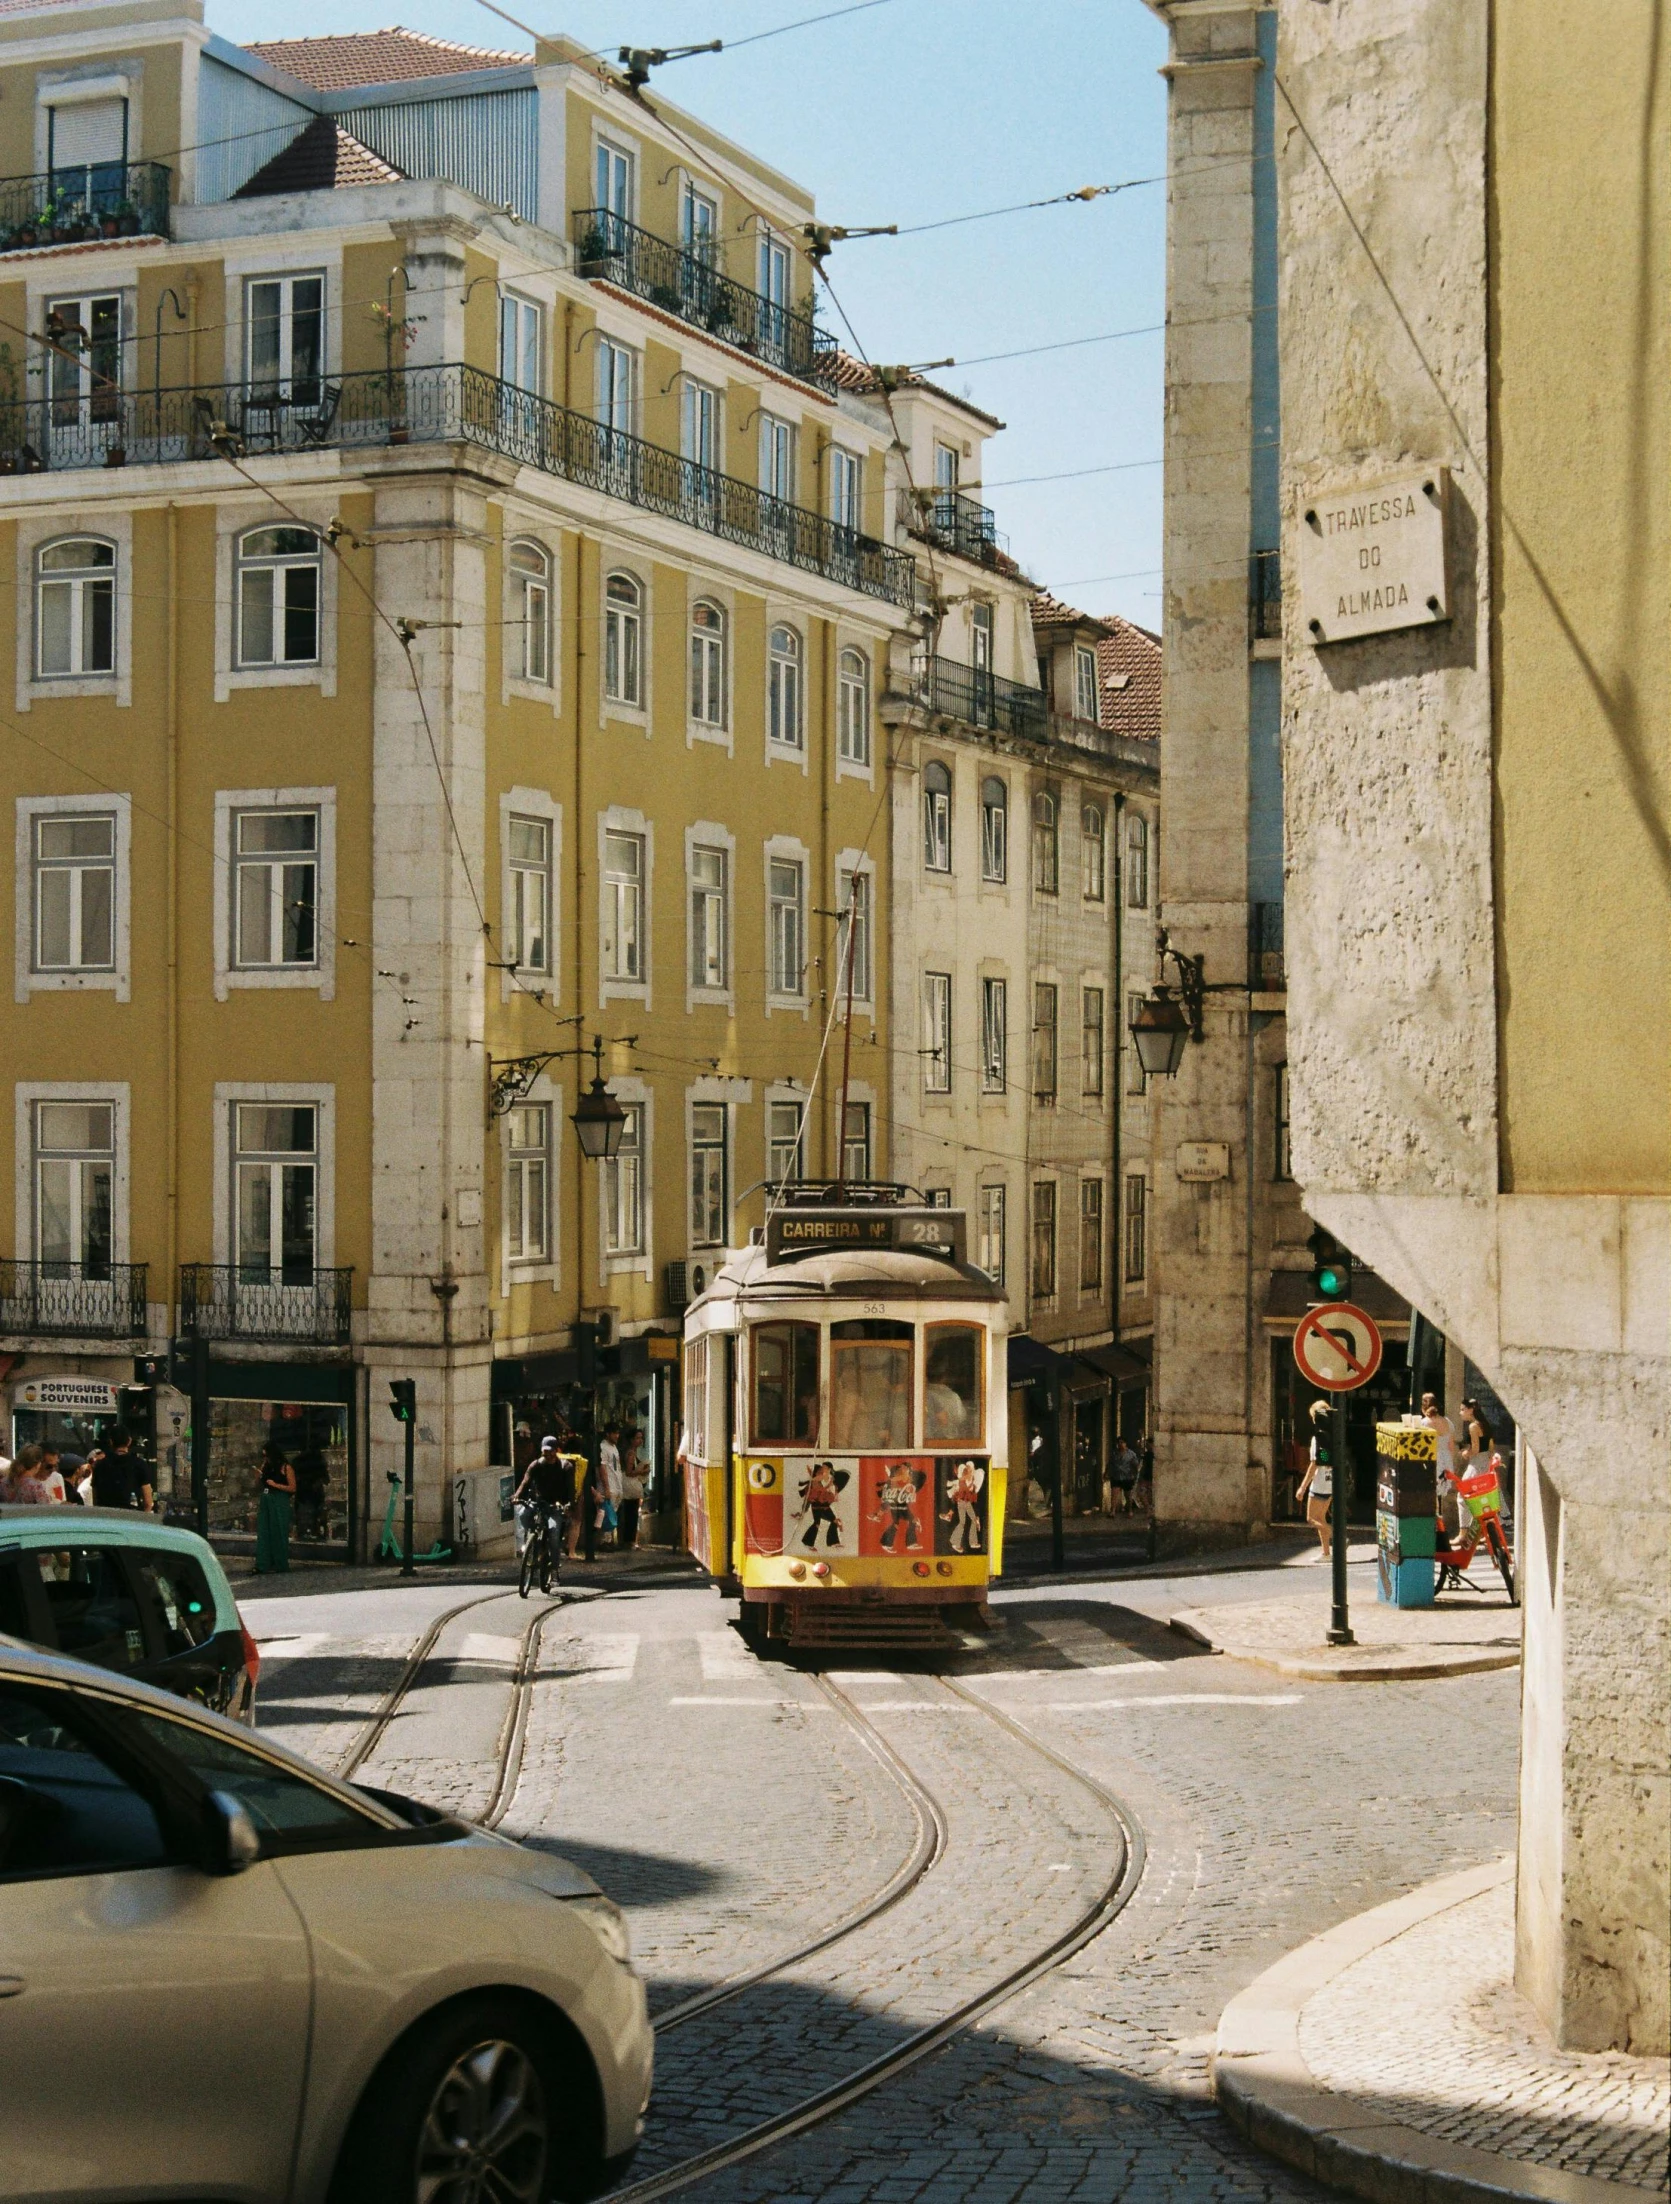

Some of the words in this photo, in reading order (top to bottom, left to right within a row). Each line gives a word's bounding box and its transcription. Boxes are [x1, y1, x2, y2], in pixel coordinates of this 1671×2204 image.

[1325, 494, 1416, 535] TRAVESSA
[1359, 545, 1381, 570] DO
[1337, 583, 1409, 618] ALMADA
[782, 1222, 860, 1238] CARREIRA
[912, 1223, 940, 1242] 28
[863, 1303, 886, 1314] 563
[41, 1383, 109, 1394] PORTUGUESE
[40, 1394, 109, 1404] SOUVENIRS
